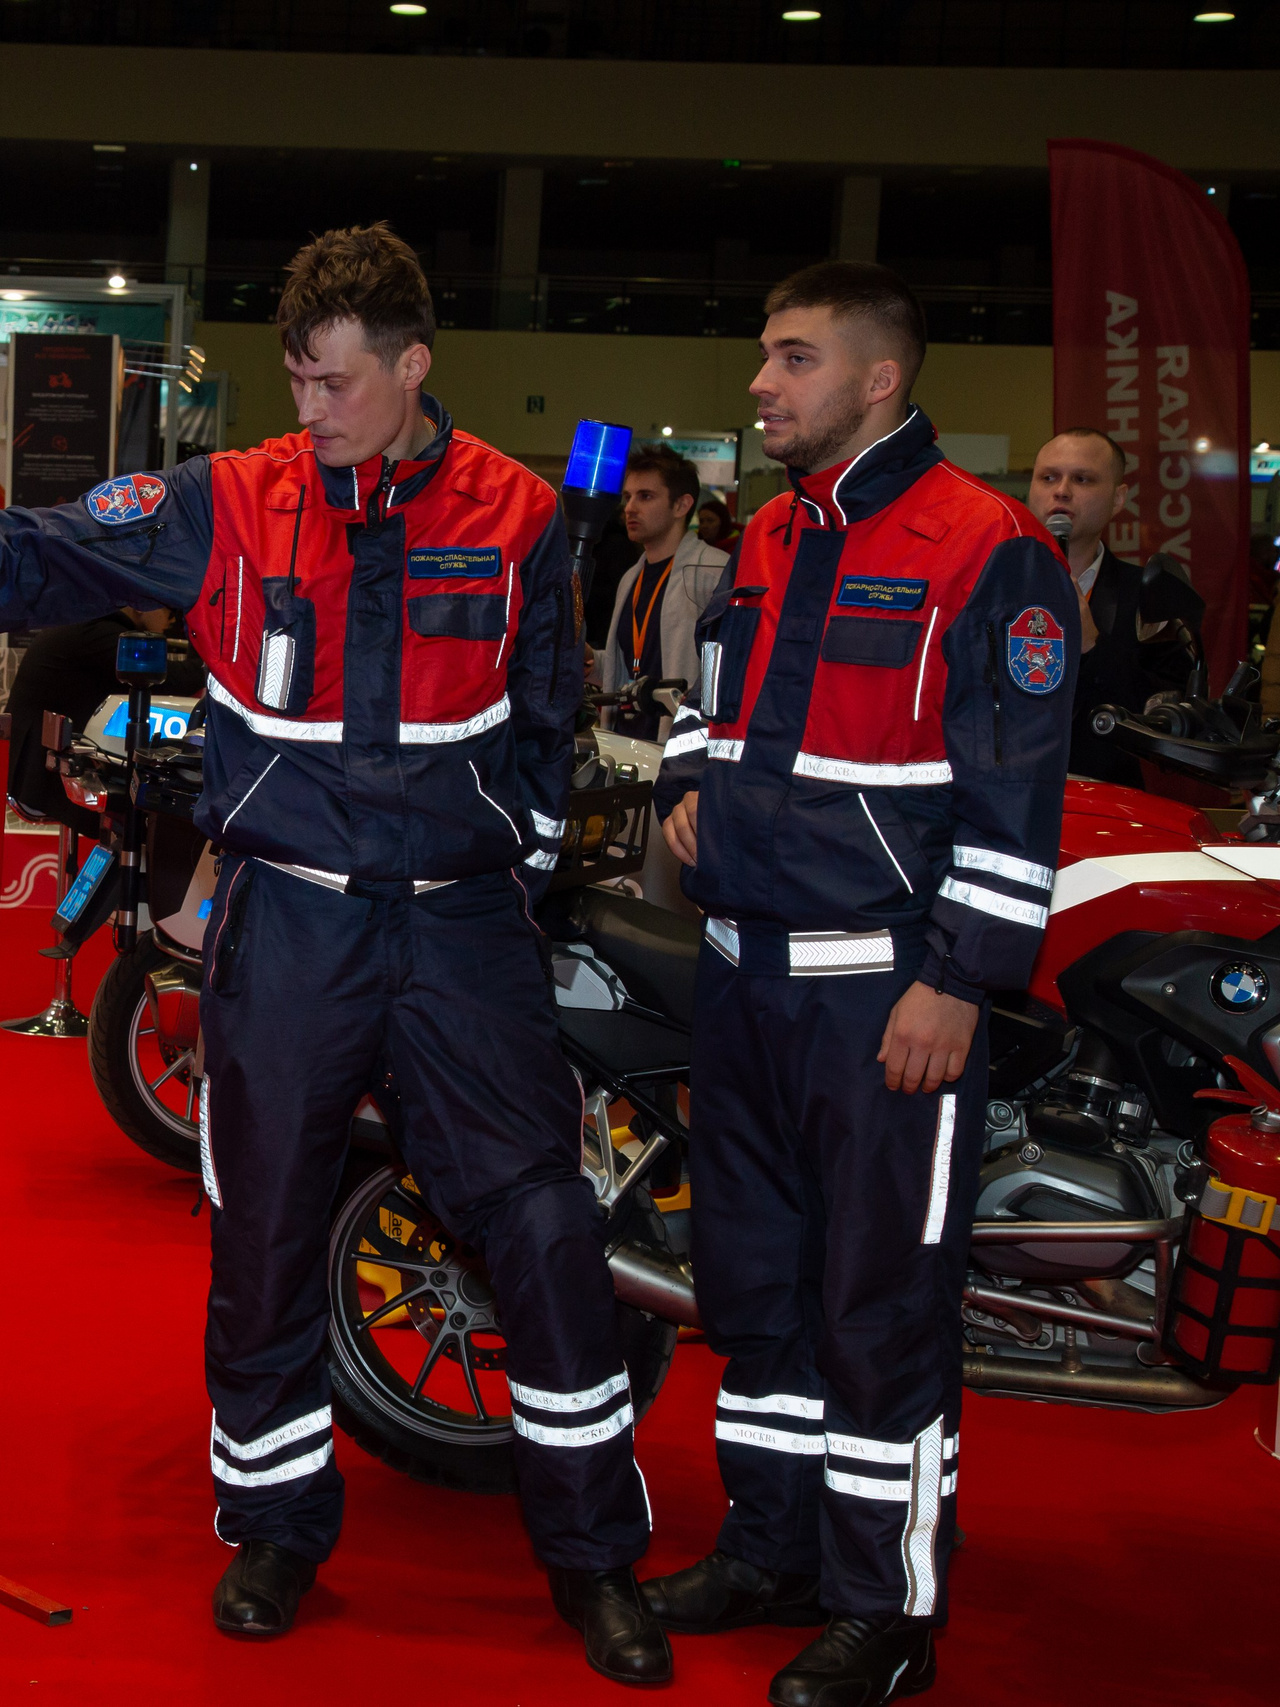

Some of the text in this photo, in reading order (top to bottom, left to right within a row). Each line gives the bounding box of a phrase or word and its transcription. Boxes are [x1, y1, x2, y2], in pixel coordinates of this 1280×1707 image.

[439, 562, 468, 570] СЛУЖБА
[808, 761, 948, 780] МОСКВА МОСК
[994, 900, 1040, 921] МОСКВА
[938, 1142, 951, 1196] МОСКВА
[266, 1422, 310, 1447] МОСКВА
[734, 1428, 777, 1444] МОСКВА
